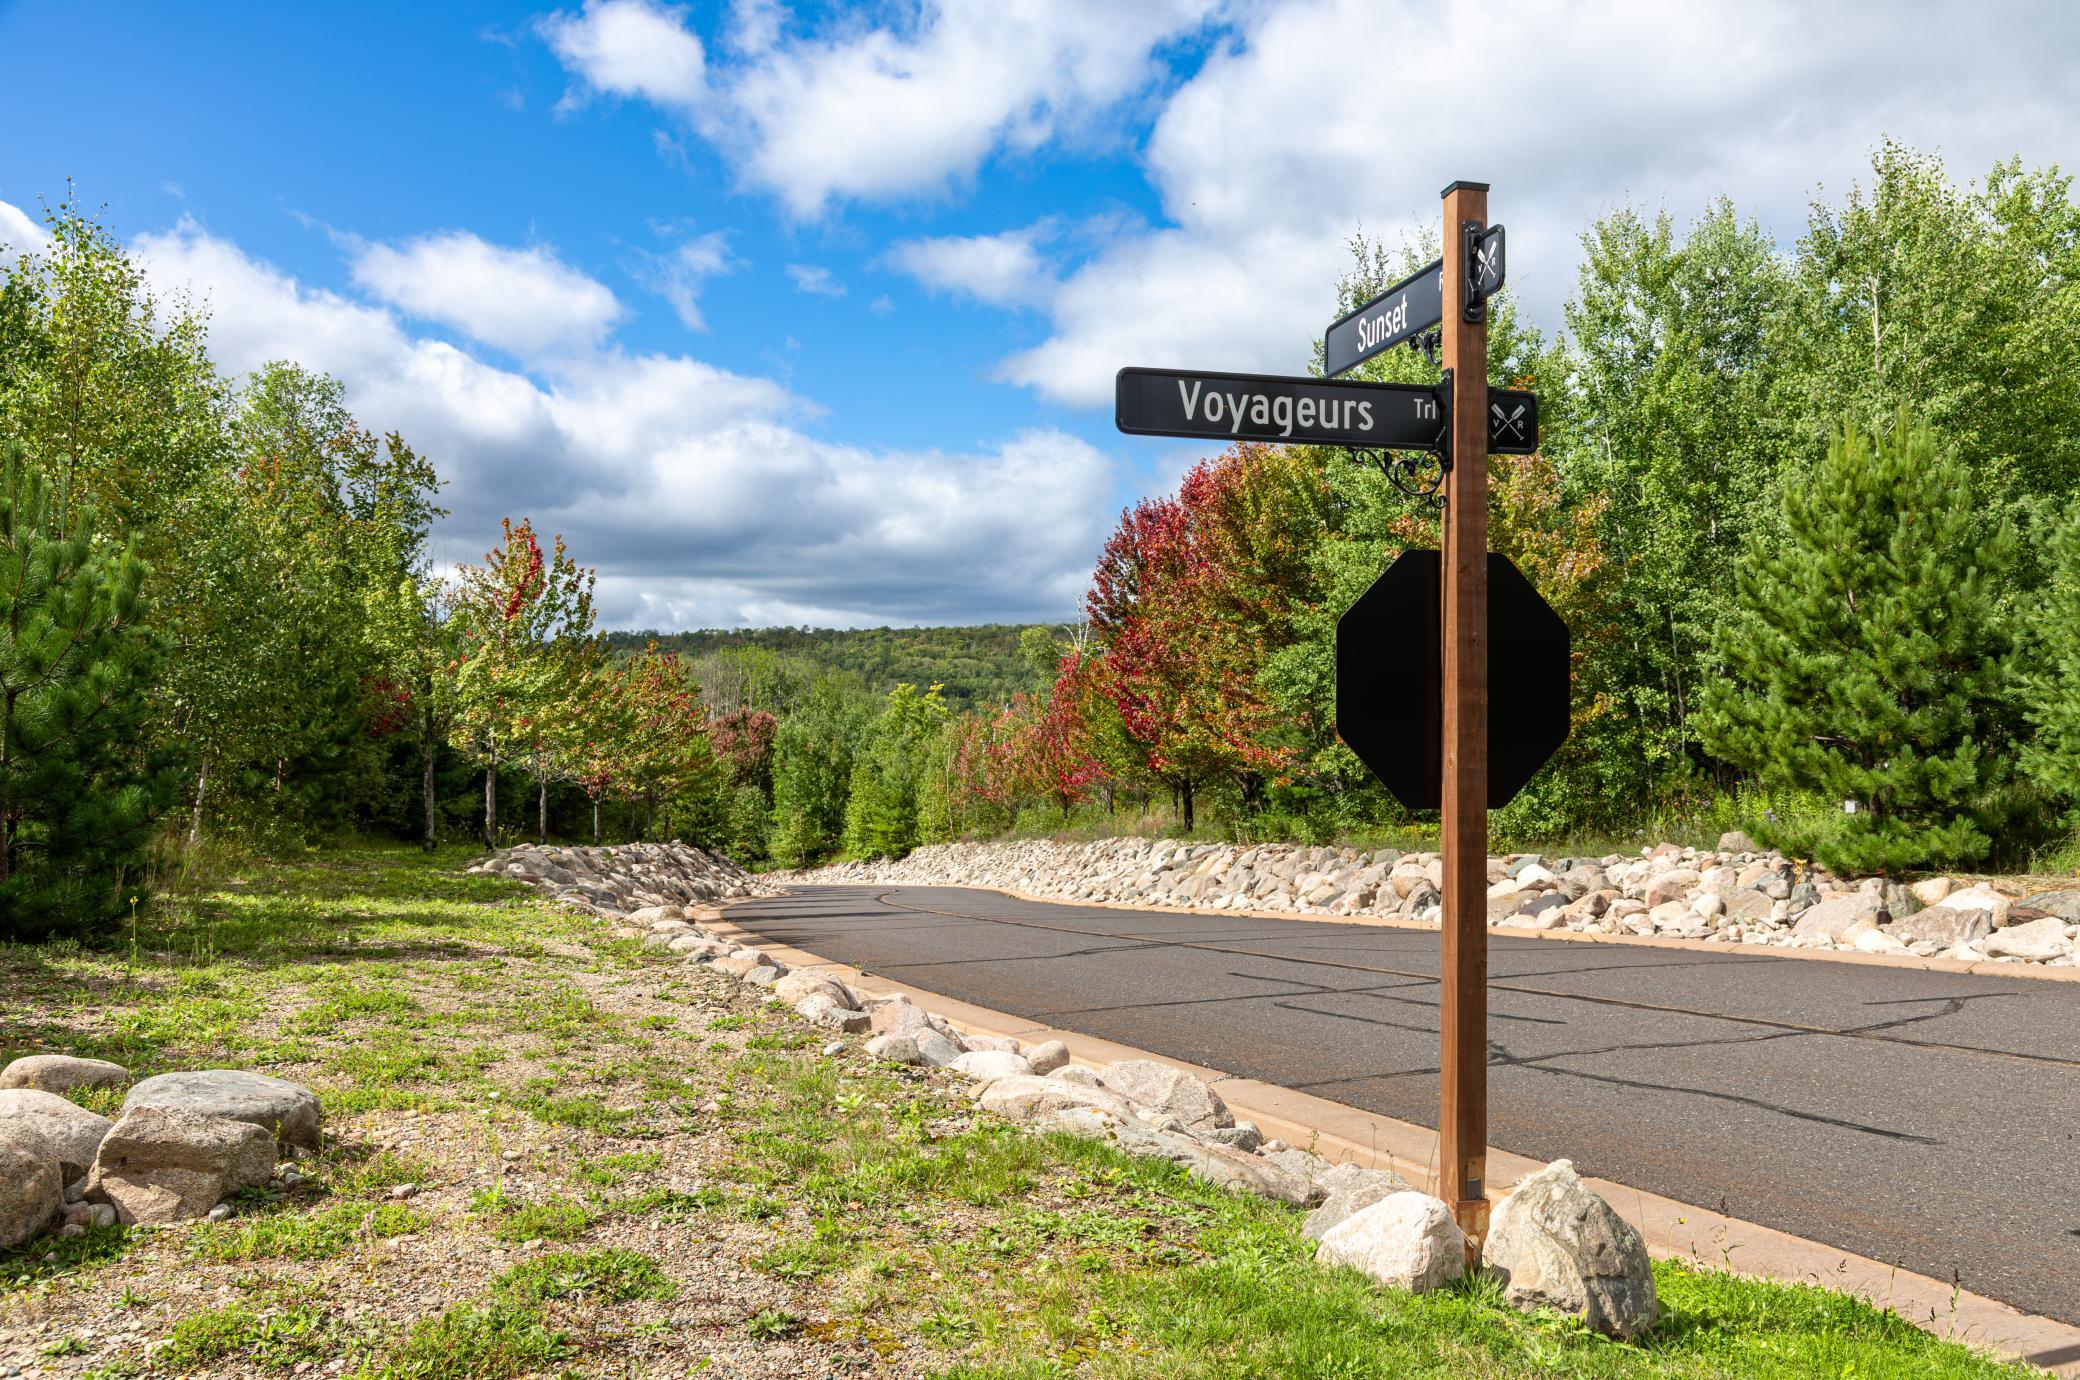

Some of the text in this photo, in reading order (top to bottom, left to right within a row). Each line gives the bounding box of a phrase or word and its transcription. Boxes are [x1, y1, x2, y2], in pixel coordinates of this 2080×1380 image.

[1357, 293, 1408, 353] Sunset
[1178, 379, 1436, 437] Voyageurs Trl
[1493, 419, 1524, 429] V R
